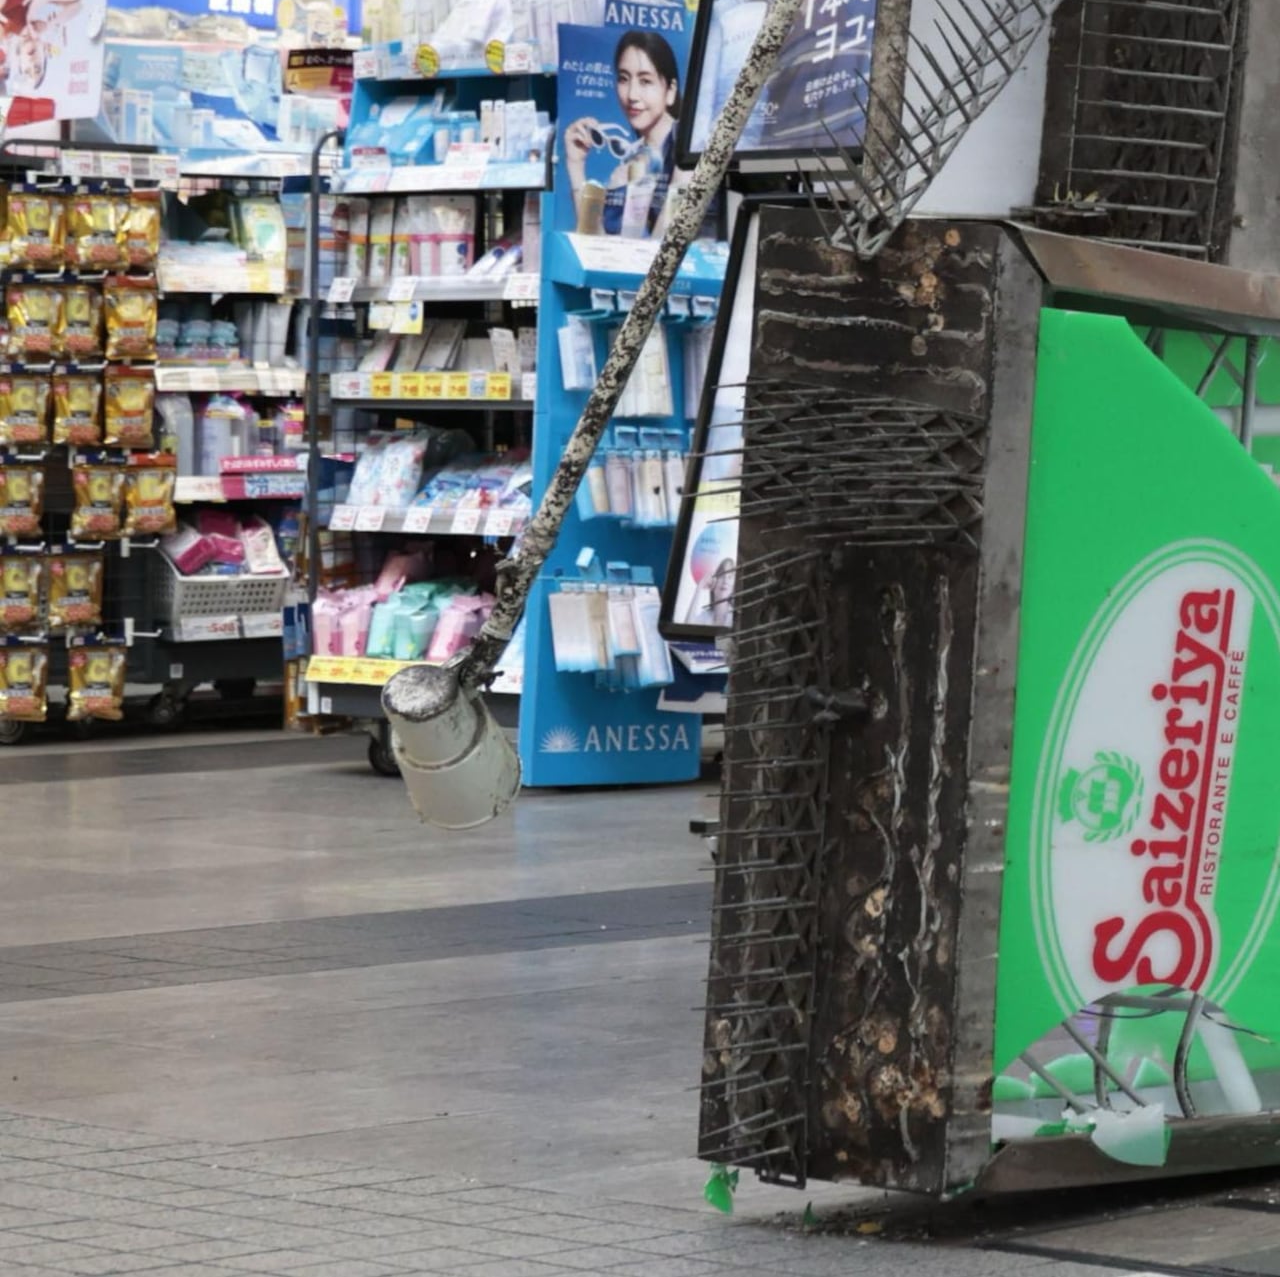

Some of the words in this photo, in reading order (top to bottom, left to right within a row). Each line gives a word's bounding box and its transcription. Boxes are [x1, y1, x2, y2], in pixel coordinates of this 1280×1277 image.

[604, 1, 685, 33] ANESSA
[584, 723, 690, 752] ANESSA
[1092, 586, 1235, 990] Saizeriya
[1200, 757, 1231, 896] RISTORANTE
[1220, 732, 1234, 745] E
